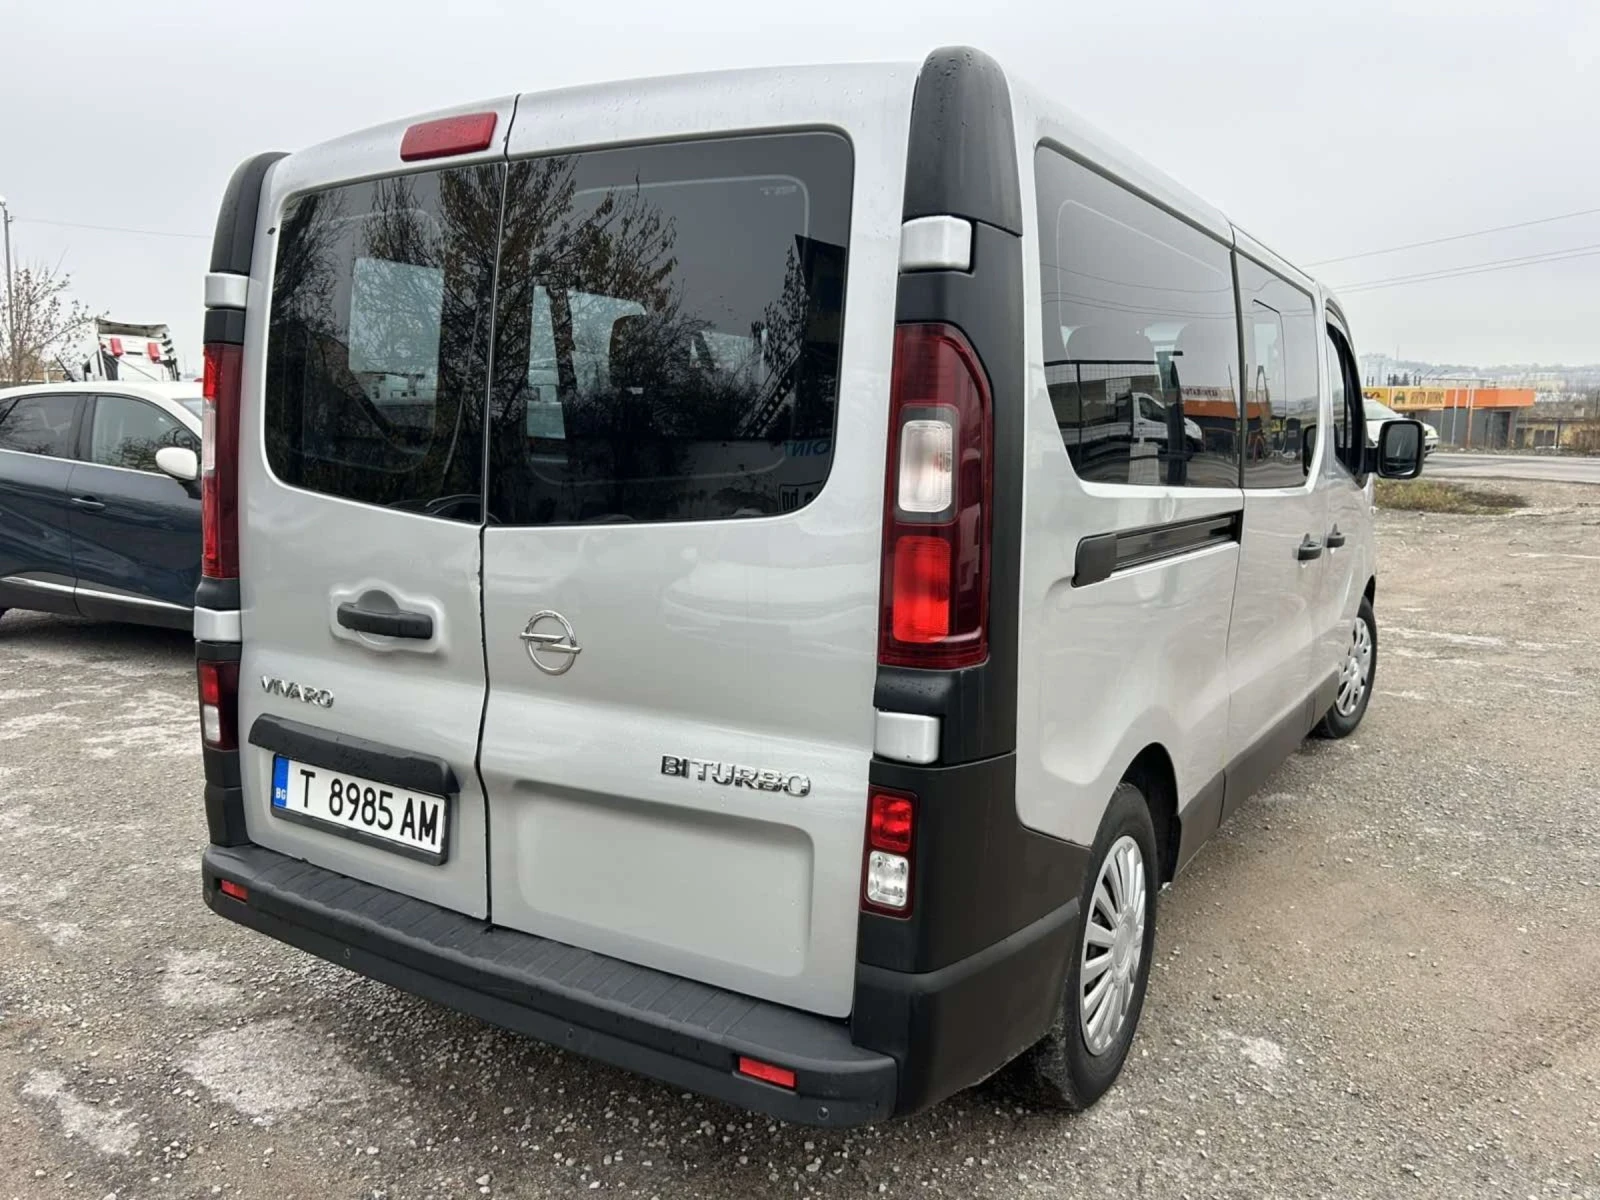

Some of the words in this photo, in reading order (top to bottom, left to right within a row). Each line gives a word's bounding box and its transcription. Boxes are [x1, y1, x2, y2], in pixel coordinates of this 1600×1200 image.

[260, 675, 335, 708] VIVARO
[275, 787, 287, 800] BG
[661, 754, 811, 797] BITURBO
[299, 768, 316, 808] T
[328, 778, 394, 831] 8985
[399, 797, 439, 846] AM
